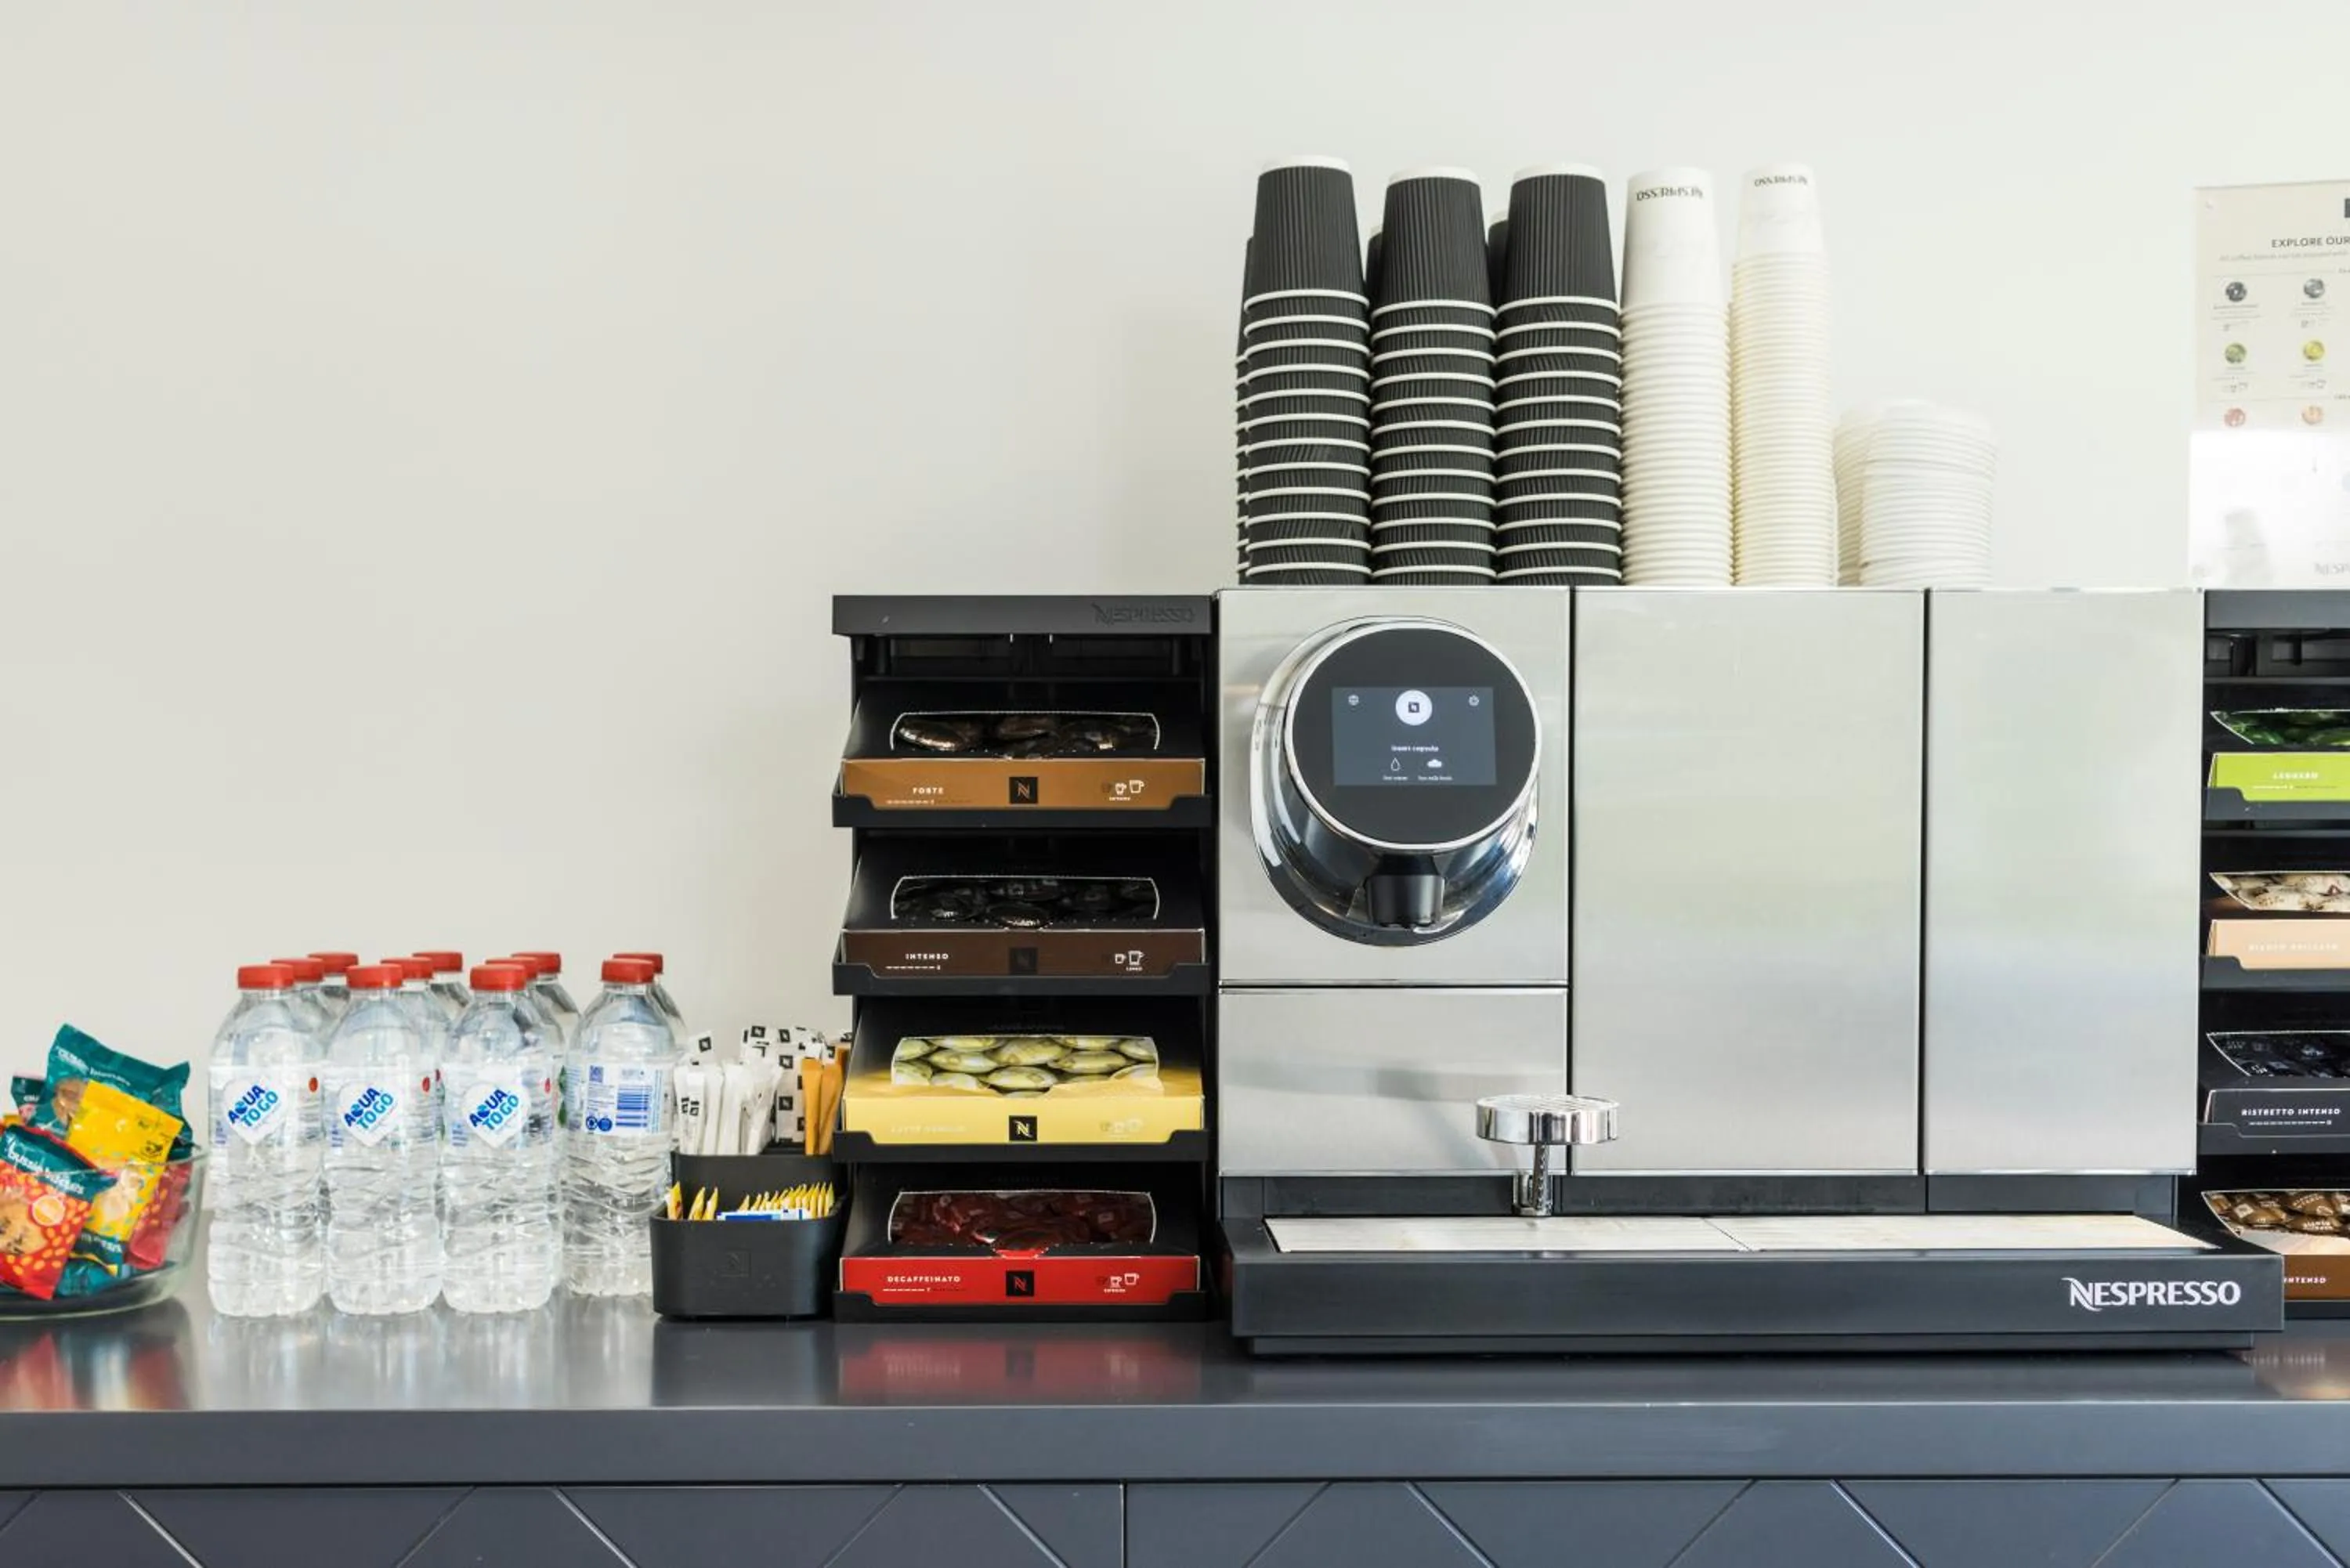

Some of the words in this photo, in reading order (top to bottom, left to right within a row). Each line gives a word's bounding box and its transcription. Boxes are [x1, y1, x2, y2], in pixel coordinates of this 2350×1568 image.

[2271, 237, 2323, 248] EXPLORE
[227, 1084, 266, 1124] AQUA
[344, 1087, 381, 1127] AQUA
[468, 1088, 508, 1128] AQUA
[2061, 1277, 2241, 1312] NESPRESSO
